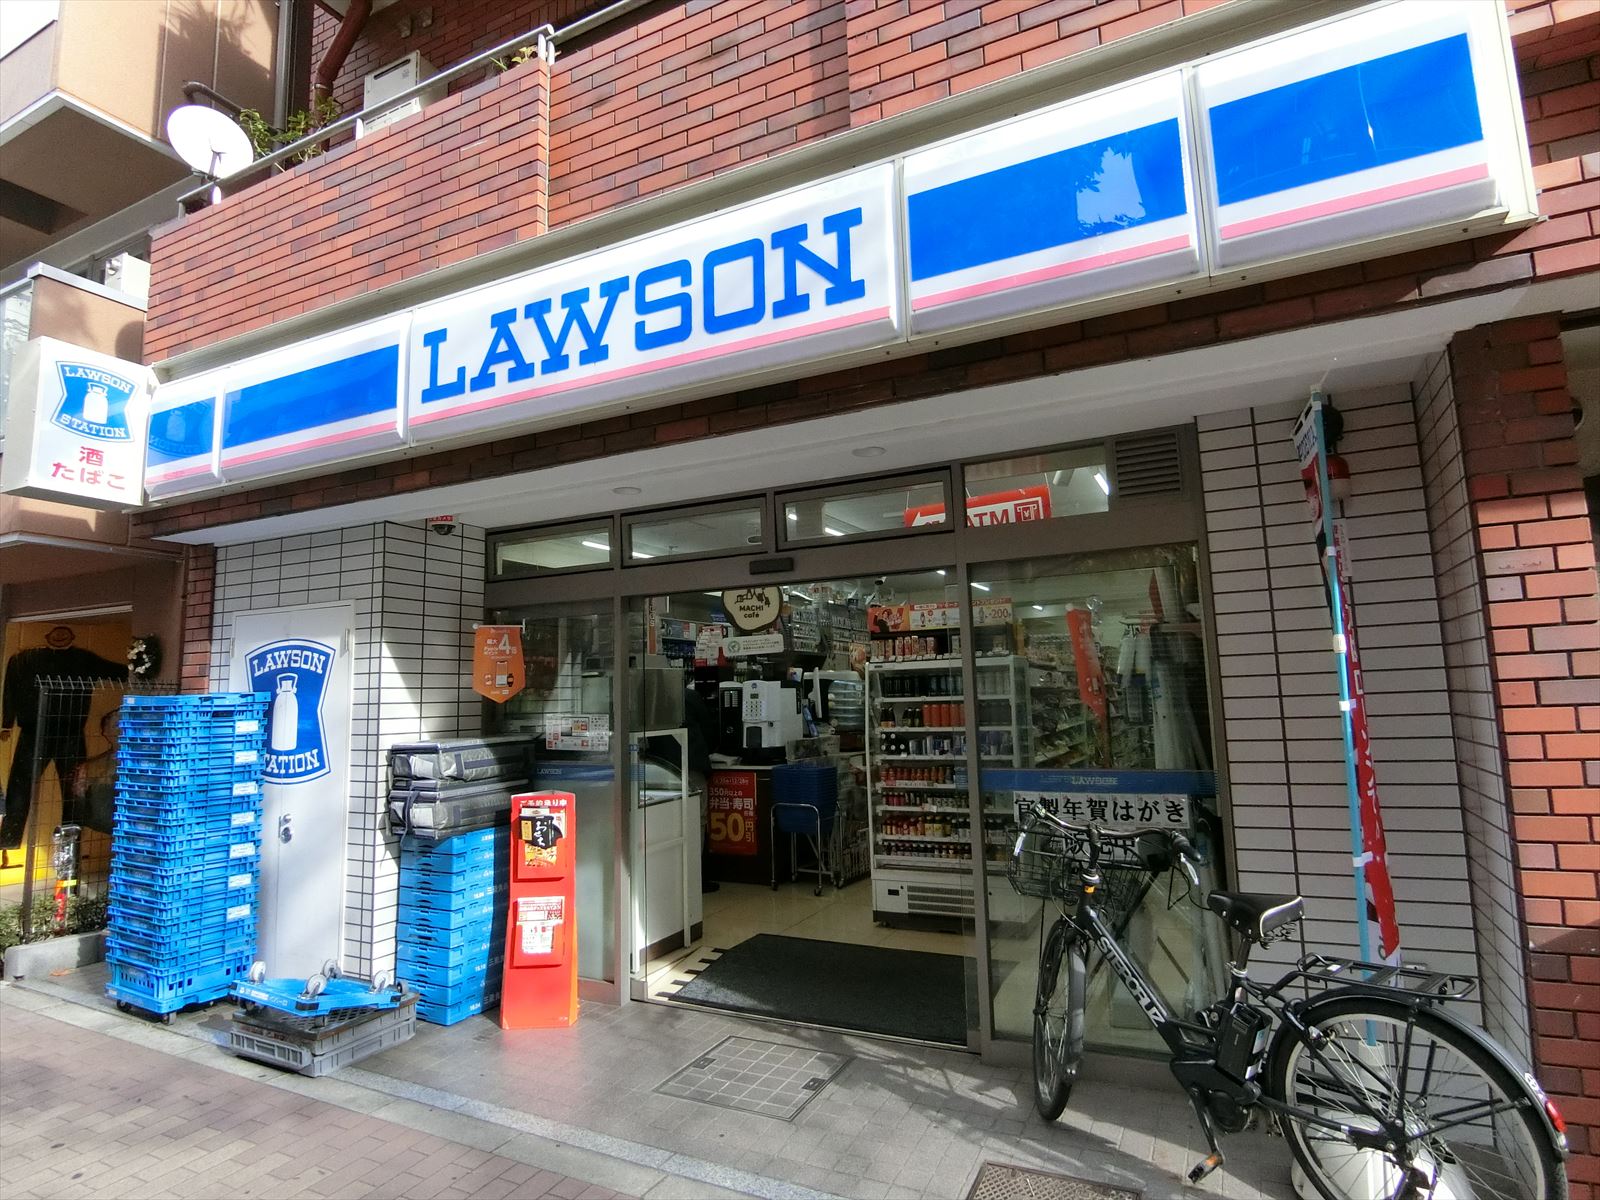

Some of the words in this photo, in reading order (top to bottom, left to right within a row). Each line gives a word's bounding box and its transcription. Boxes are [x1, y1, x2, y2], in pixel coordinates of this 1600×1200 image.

[421, 206, 866, 404] LAWSON
[63, 366, 133, 394] LAWSON
[60, 413, 127, 438] STATION
[79, 446, 104, 467] 酒
[51, 462, 125, 490] たばこ
[739, 604, 764, 612] MACHI
[253, 649, 326, 677] LAWSON
[264, 748, 320, 774] TATION
[1098, 935, 1166, 1028] STEPCRUZ
